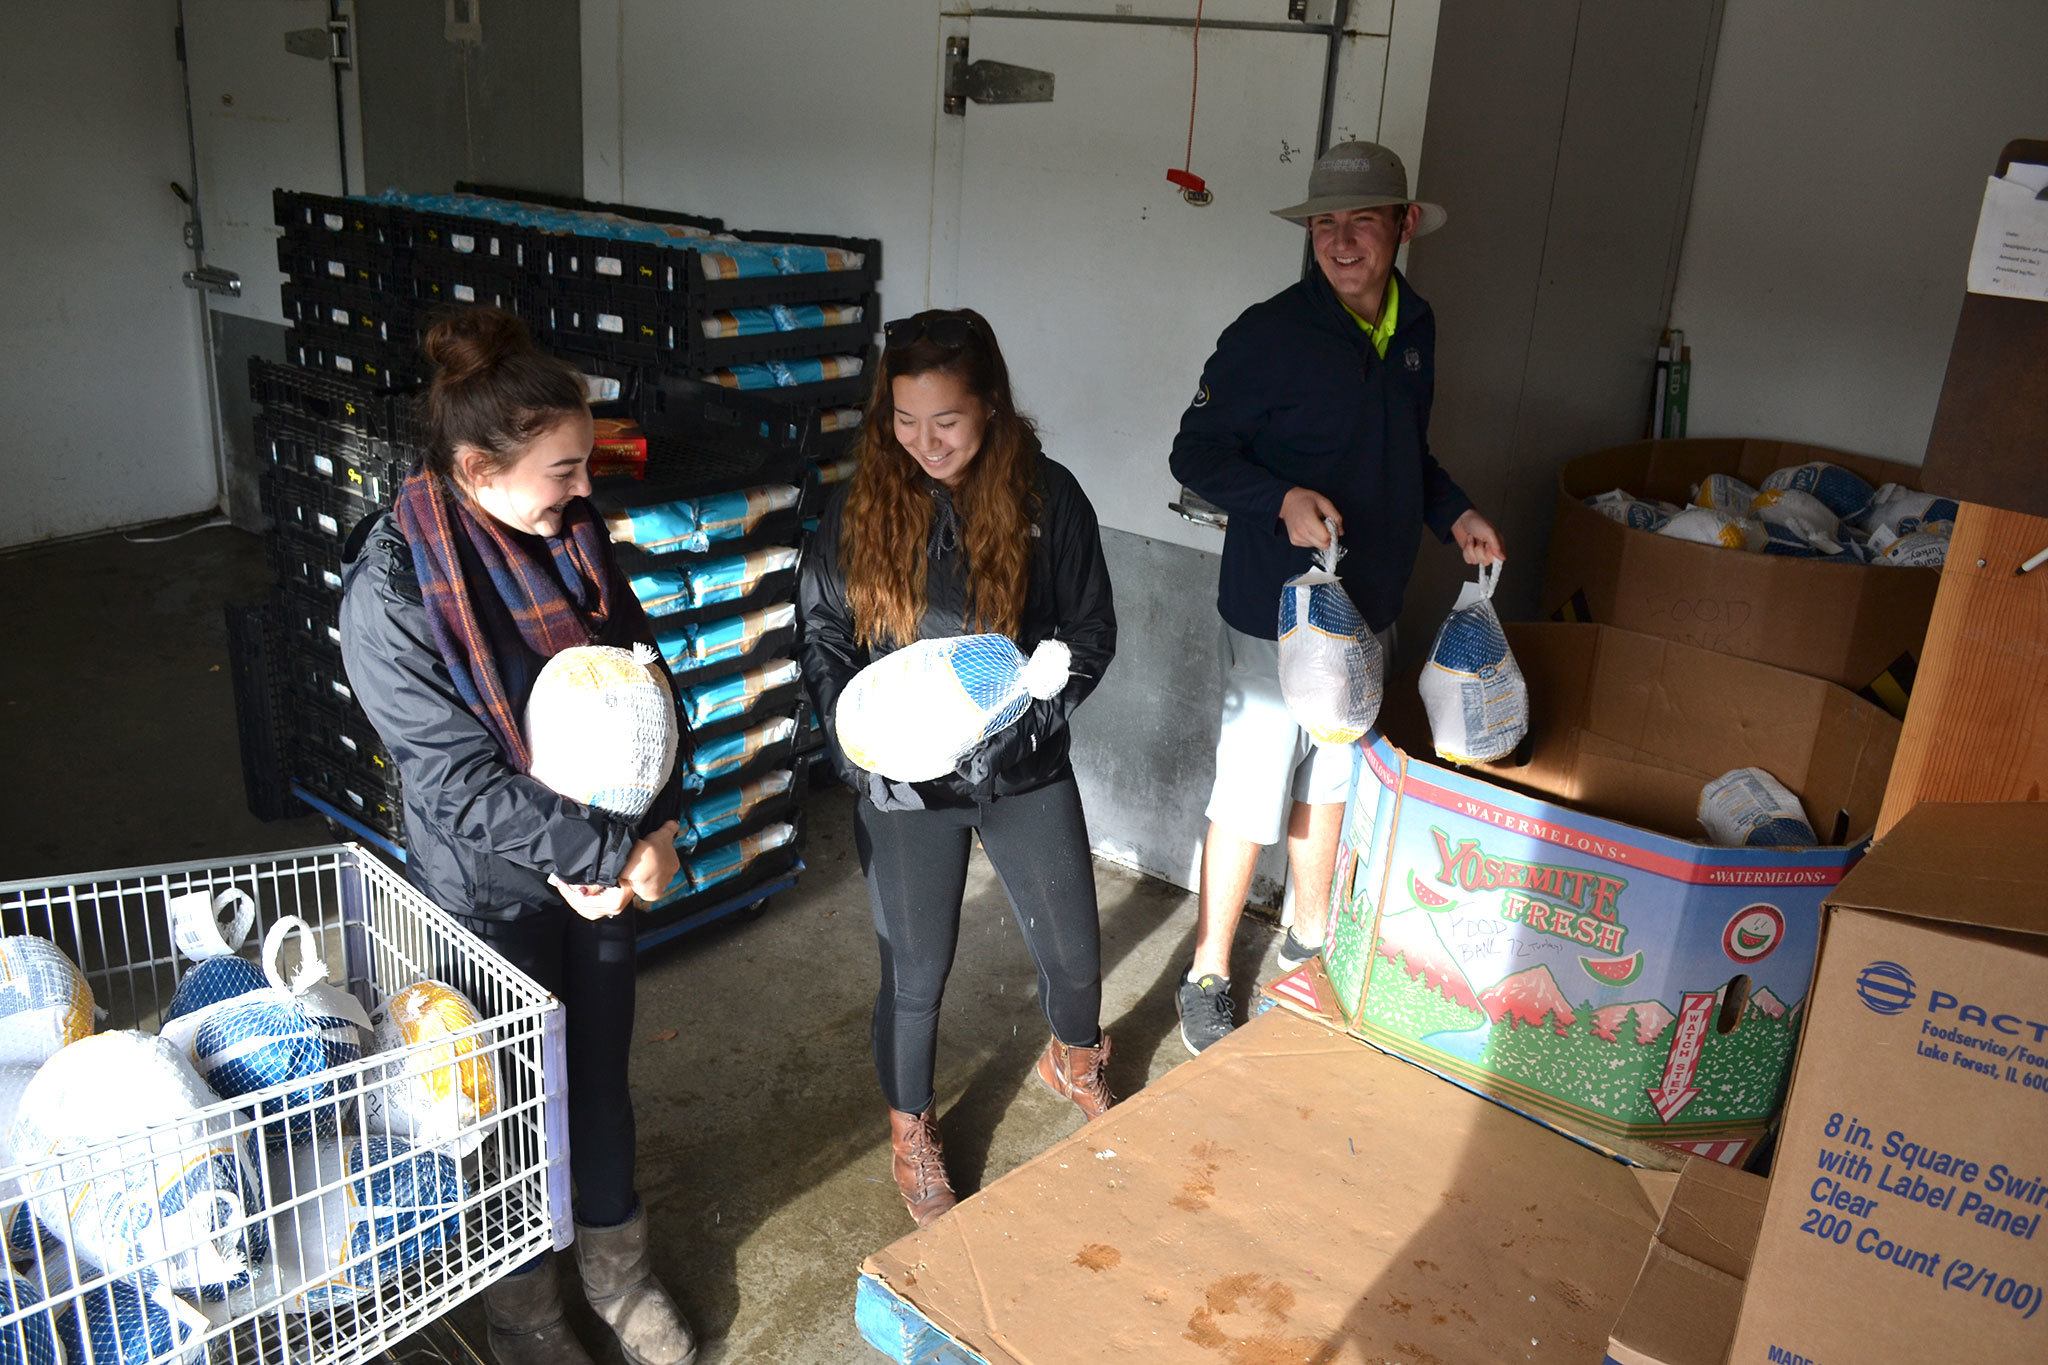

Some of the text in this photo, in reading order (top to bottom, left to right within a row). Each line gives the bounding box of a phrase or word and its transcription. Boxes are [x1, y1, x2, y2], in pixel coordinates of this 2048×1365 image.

[1431, 827, 1628, 925] YOSEMITE
[1504, 893, 1627, 955] FRESH
[1928, 990, 2048, 1043] PACT
[1668, 1013, 1700, 1097] WATCH STEP
[1916, 1040, 1949, 1062] Lake
[1952, 1051, 2000, 1079] Forest,
[2005, 1067, 2018, 1083] IL
[1824, 1112, 1844, 1138] 8
[1843, 1118, 1873, 1150] in.
[1881, 1131, 1980, 1184] Square
[1810, 1177, 1878, 1219] Clear
[1818, 1148, 2041, 1240] with Label Panel
[1800, 1208, 2043, 1319] 200 Count (2/100)
